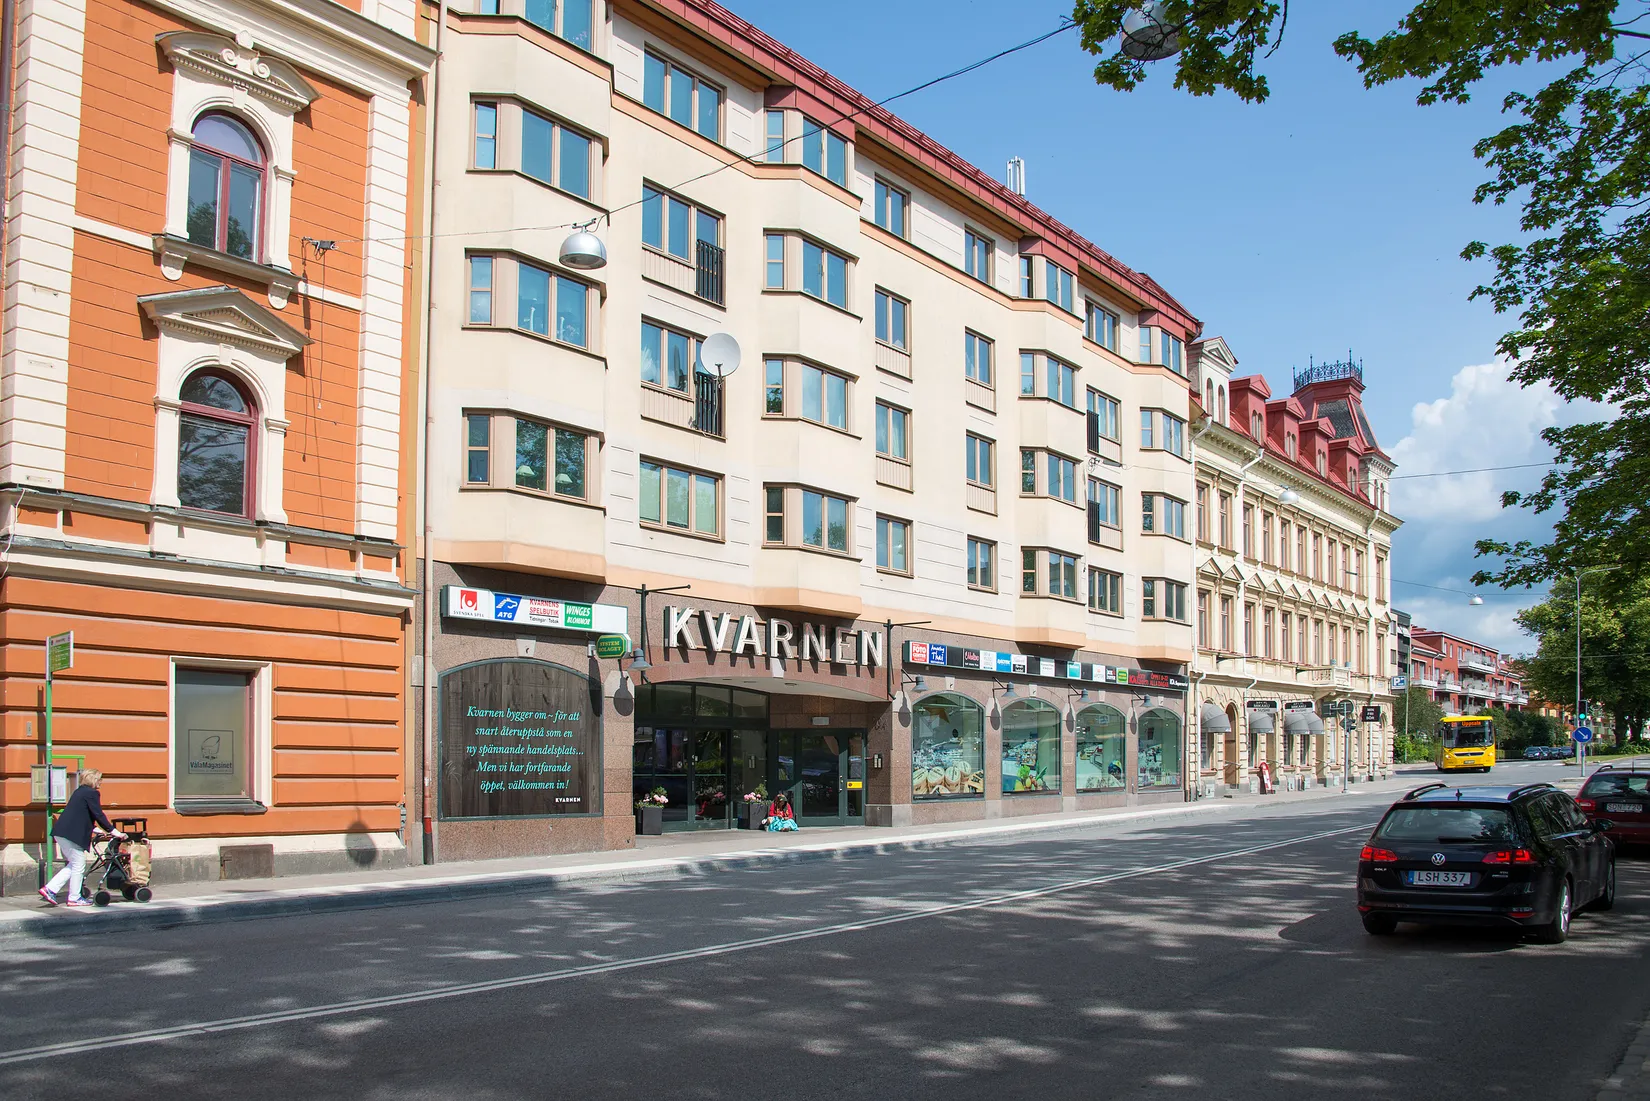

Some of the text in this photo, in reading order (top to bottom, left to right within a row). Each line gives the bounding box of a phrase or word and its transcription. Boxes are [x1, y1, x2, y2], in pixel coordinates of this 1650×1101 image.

[497, 611, 513, 619] ATG
[529, 607, 559, 616] SPELBUTIK
[566, 605, 591, 616] WINGES
[664, 605, 882, 667] KVARNEN
[931, 651, 944, 661] Thai
[467, 705, 505, 717] Kvarnen
[506, 708, 533, 722] bygger
[534, 712, 547, 720] om
[553, 710, 567, 723] för
[568, 712, 580, 721] att
[475, 726, 573, 739] snart återuppstå som en
[466, 745, 477, 757] ny
[478, 744, 525, 757] spännande
[476, 761, 572, 775] Men vi har fortfarande
[480, 779, 570, 793] öppet, välkommen in!
[1417, 872, 1466, 883] LSH 337
